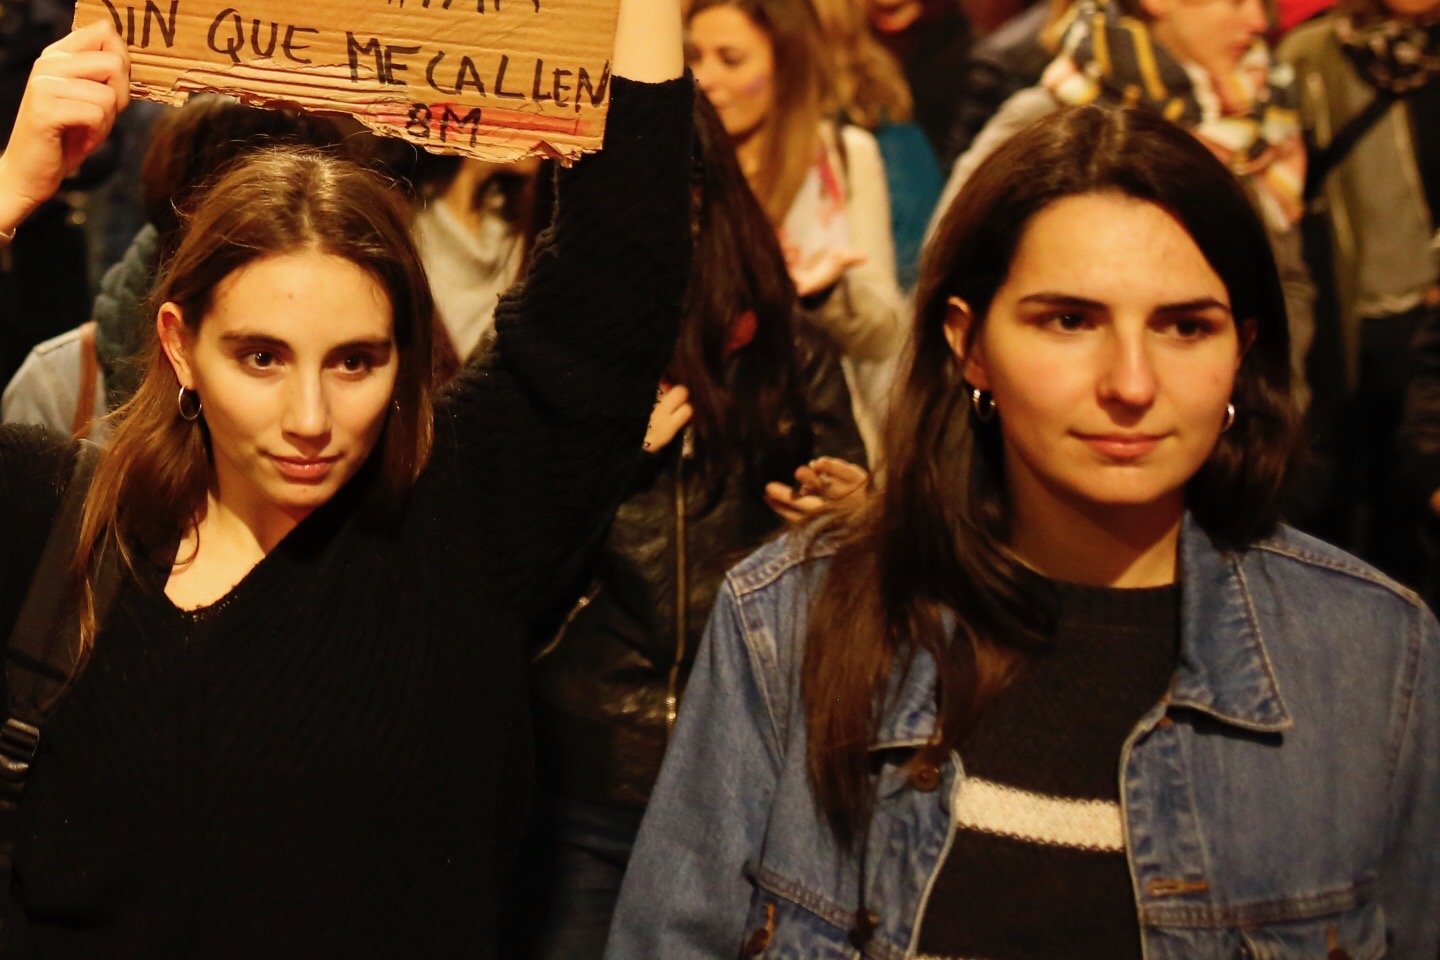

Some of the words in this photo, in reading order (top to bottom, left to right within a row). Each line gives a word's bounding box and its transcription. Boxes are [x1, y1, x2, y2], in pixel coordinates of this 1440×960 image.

[206, 6, 320, 65] QUE
[344, 30, 423, 87] ME
[424, 49, 612, 110] CALLEN
[405, 102, 482, 148] 8M
